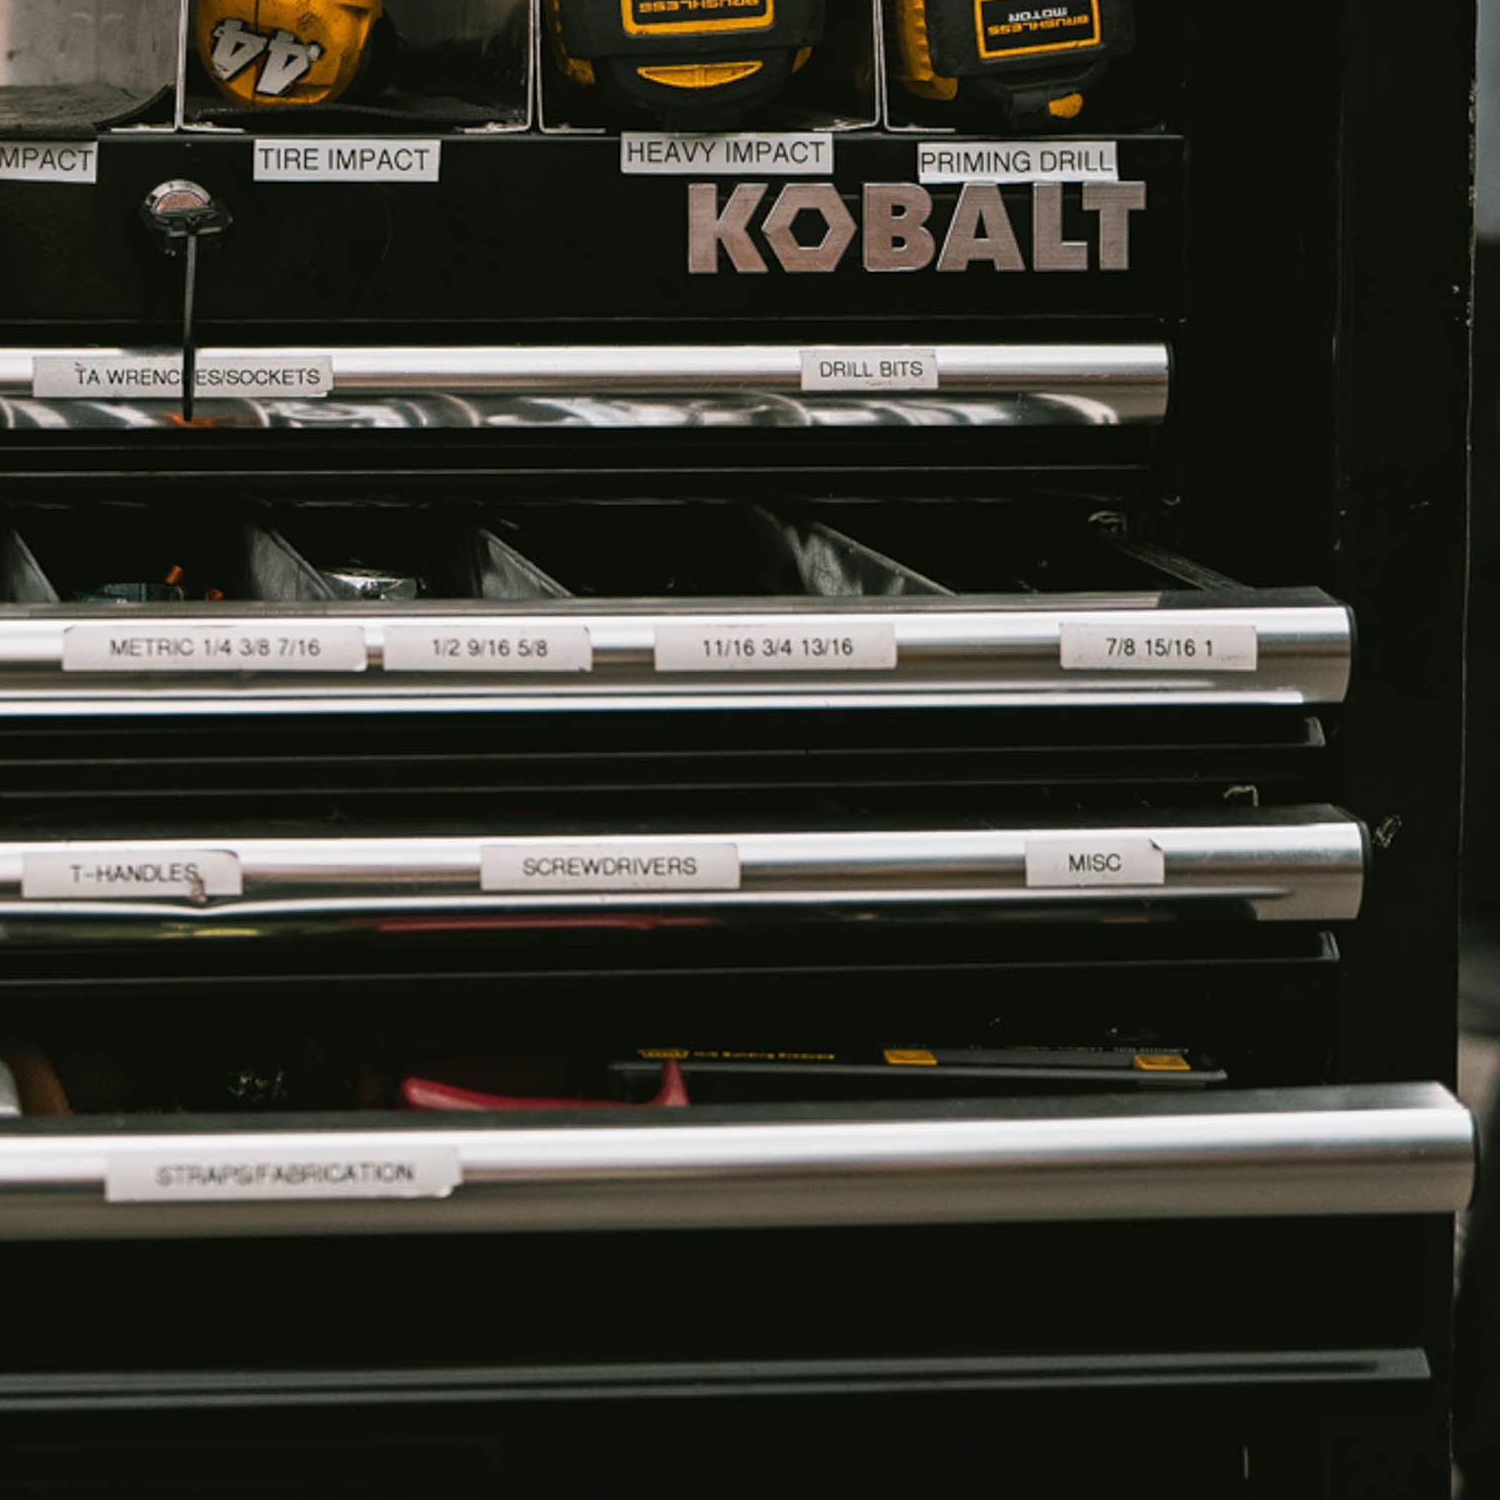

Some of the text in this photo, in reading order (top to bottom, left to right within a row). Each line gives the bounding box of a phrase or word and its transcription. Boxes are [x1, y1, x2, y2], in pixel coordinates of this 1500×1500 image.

[987, 14, 1090, 36] BRUSHLESS
[1008, 7, 1068, 23] MOTOR
[213, 18, 321, 95] 44
[259, 148, 430, 171] TIRE IMPACT
[627, 140, 827, 165] HEAVY IMPACT
[920, 150, 1114, 175] PRIMING DRILL
[687, 181, 1147, 274] KOBALT
[107, 367, 321, 385] WRENCES/SOCKETS
[820, 360, 923, 377] DRILL BITS
[110, 638, 321, 657] METRIC 1/4 3/8 7/16
[433, 638, 549, 657] 1/2 9/16 5/8
[703, 637, 854, 657] 11/16 3/4 13/16
[1106, 637, 1213, 656] 7/8 15/16 1
[523, 857, 697, 877] SCREWDRIVERS
[1069, 853, 1122, 872] MISC
[71, 863, 199, 883] T-HANDLES
[156, 1161, 416, 1187] STRAPS/FABRICATION
